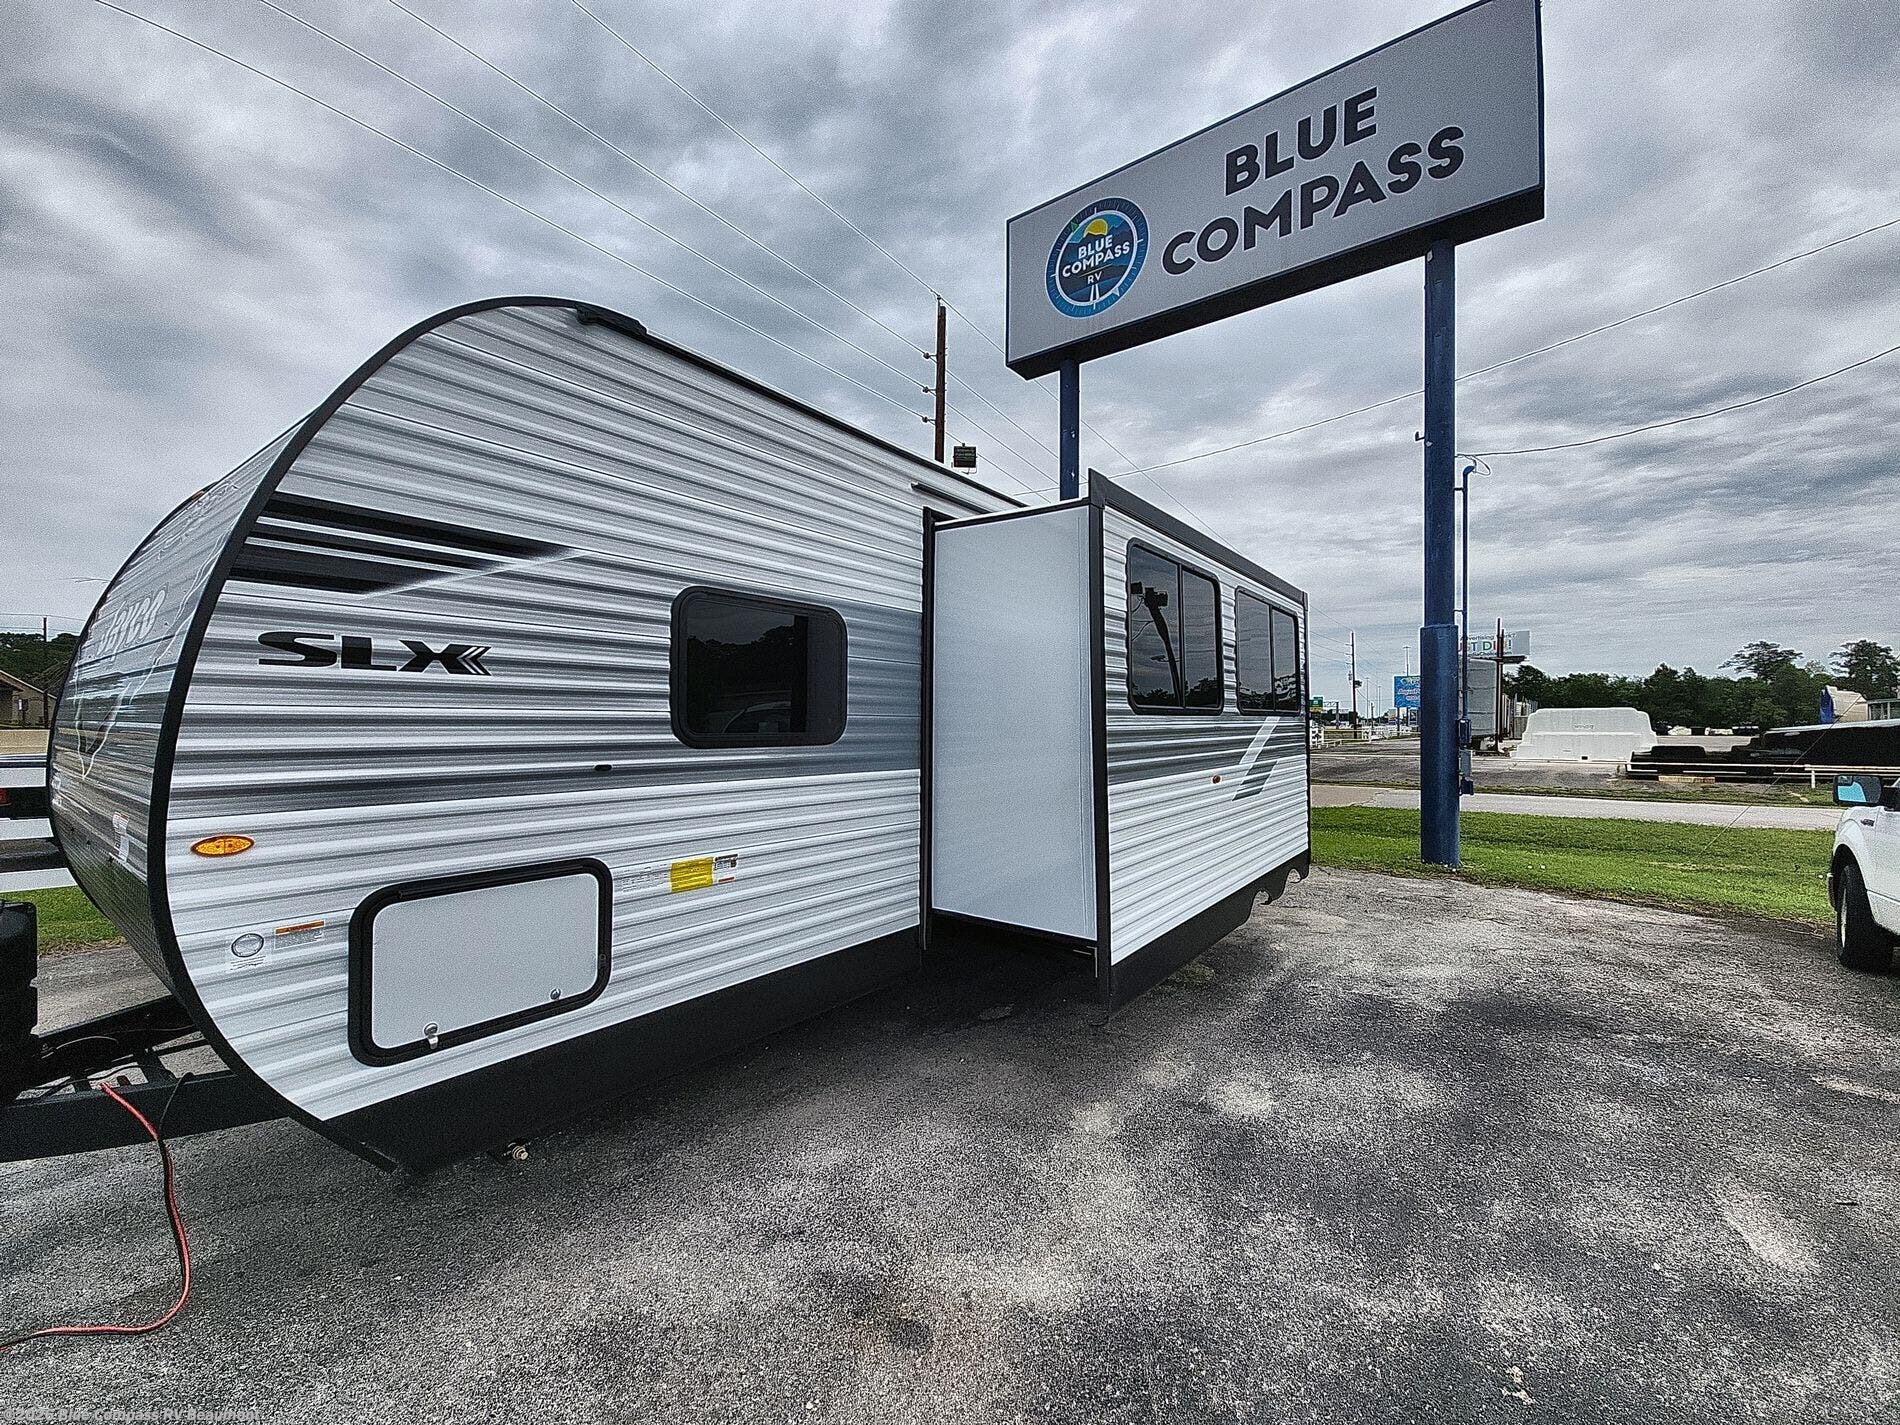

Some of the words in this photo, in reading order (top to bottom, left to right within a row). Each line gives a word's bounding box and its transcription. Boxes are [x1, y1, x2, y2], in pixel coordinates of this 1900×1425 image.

[1225, 86, 1378, 196] BLUE
[1162, 126, 1465, 276] COMPASS
[1062, 241, 1130, 277] COMPASS
[1078, 235, 1113, 259] BLUE
[1087, 271, 1102, 284] RV
[258, 631, 492, 676] SLX
